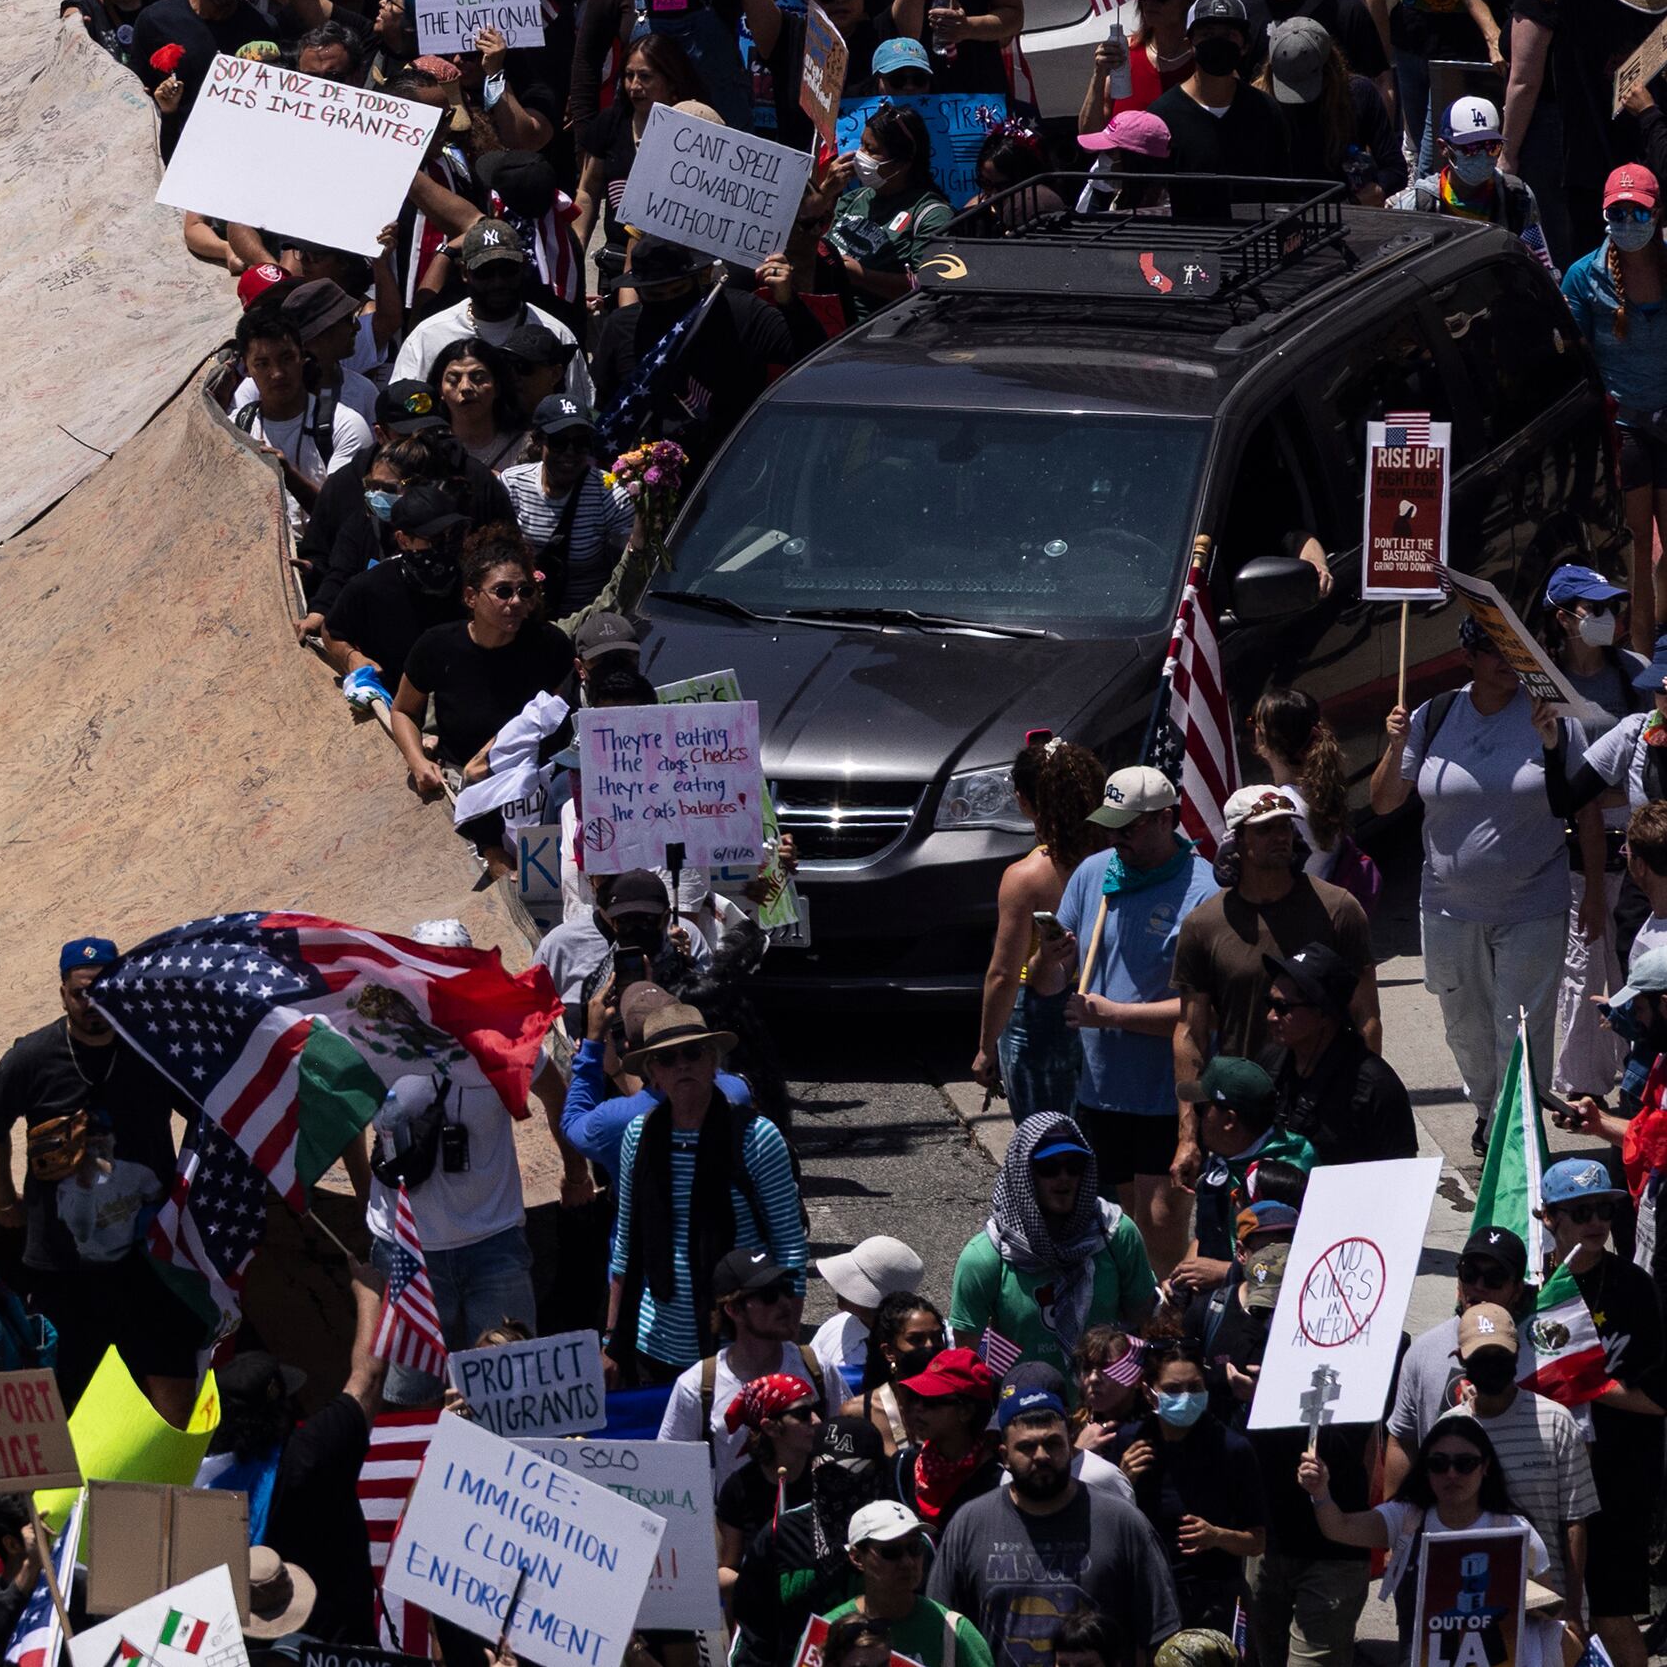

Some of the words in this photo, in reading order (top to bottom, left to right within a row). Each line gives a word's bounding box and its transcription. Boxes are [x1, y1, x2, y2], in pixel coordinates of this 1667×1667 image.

[207, 84, 257, 109] MIS
[214, 56, 251, 84] SOY
[279, 71, 312, 97] VOZ
[319, 83, 347, 103] DE
[355, 92, 410, 119] TODOS
[674, 127, 730, 164] CANT
[729, 145, 782, 184] SPELL
[670, 161, 779, 218] COWARDICE
[646, 192, 735, 244] WITHOUT
[1377, 448, 1411, 469] RISE
[1415, 448, 1441, 469] UP!
[1374, 538, 1399, 549] DON'T
[1400, 539, 1416, 550] LET
[1417, 539, 1434, 550] THE
[1383, 550, 1425, 562] BASTARDS
[1374, 562, 1394, 571] GRIND
[1395, 562, 1409, 572] YOU
[1335, 1241, 1363, 1272] NO
[1304, 1269, 1373, 1301] KINGS
[1292, 1312, 1371, 1347] AMERICA
[1327, 1301, 1342, 1316] IN
[461, 1341, 584, 1397] PROTECT
[505, 1450, 581, 1506] ICE:
[443, 1462, 619, 1572] IMMIGRATION
[464, 1522, 563, 1588] CLOWN
[407, 1541, 610, 1666] ENFORCEMENT
